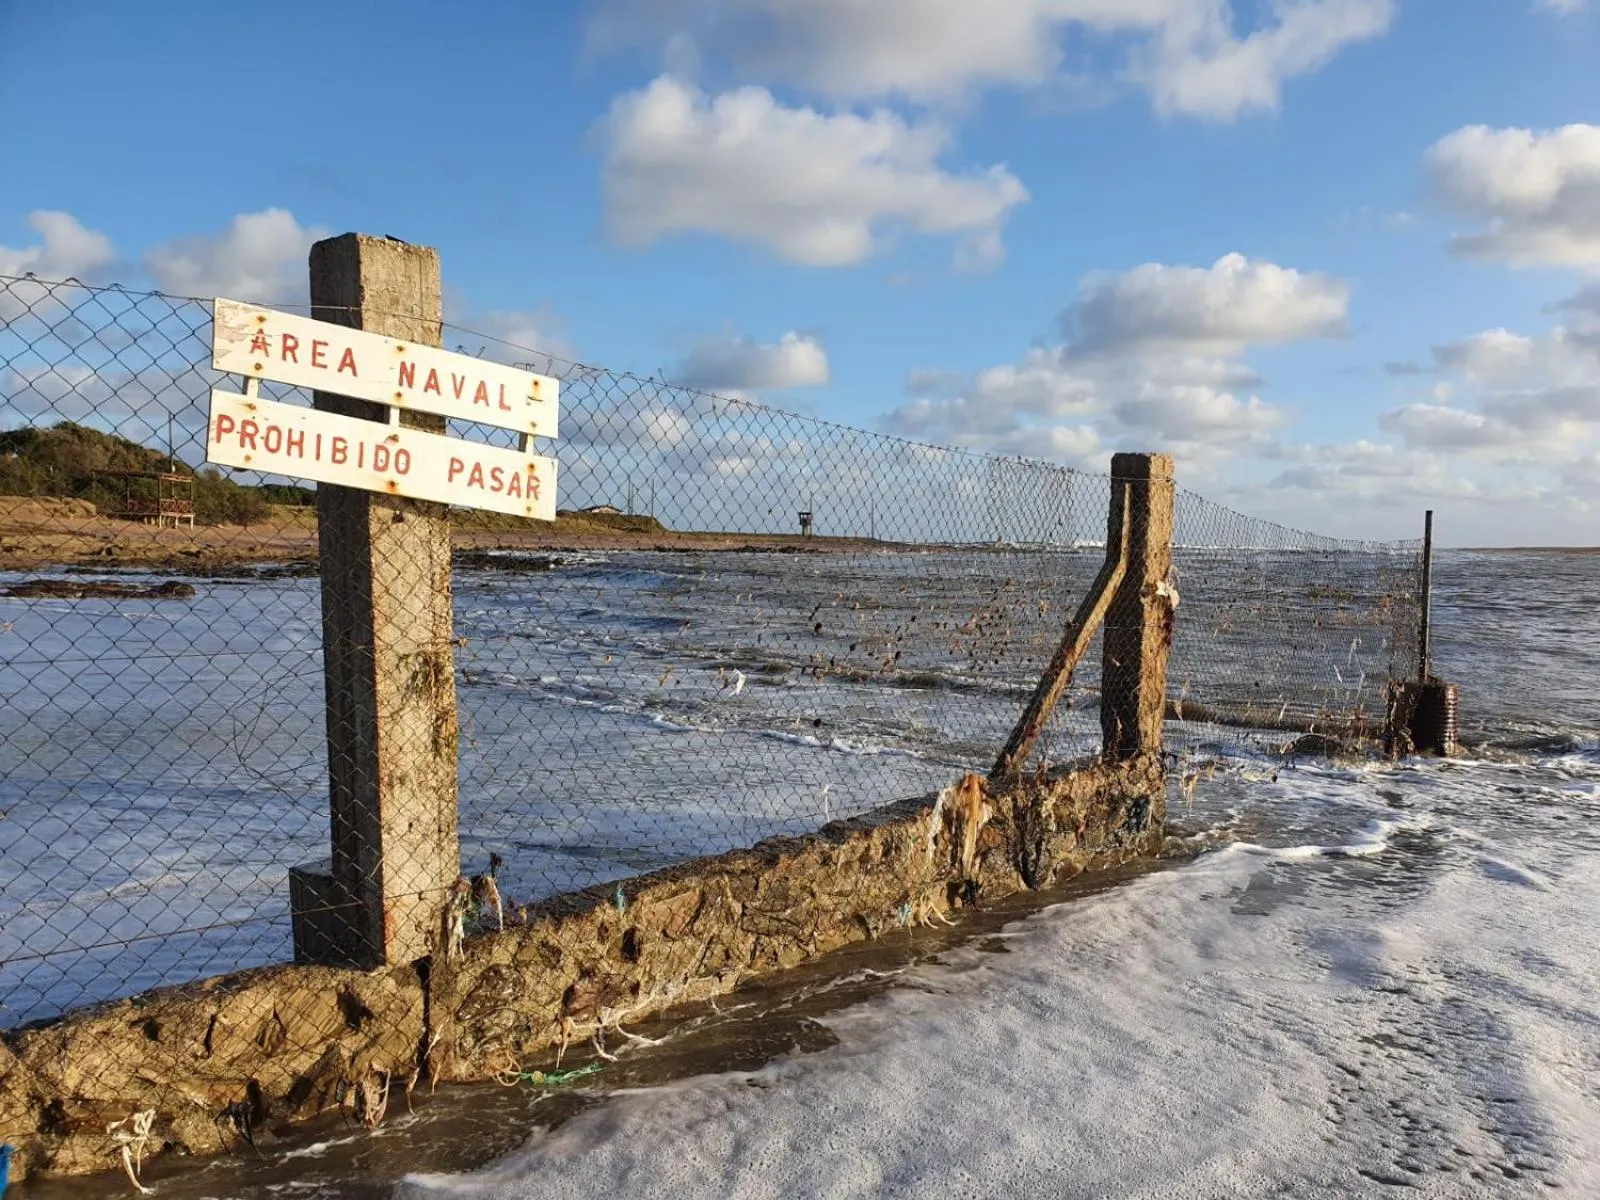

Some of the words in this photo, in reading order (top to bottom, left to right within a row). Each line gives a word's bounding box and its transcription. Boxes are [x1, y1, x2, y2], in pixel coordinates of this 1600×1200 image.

[249, 328, 358, 377] AREA
[398, 361, 512, 411] NAVAL
[215, 414, 411, 475] PROHIBIDO
[448, 457, 541, 501] PASAR
